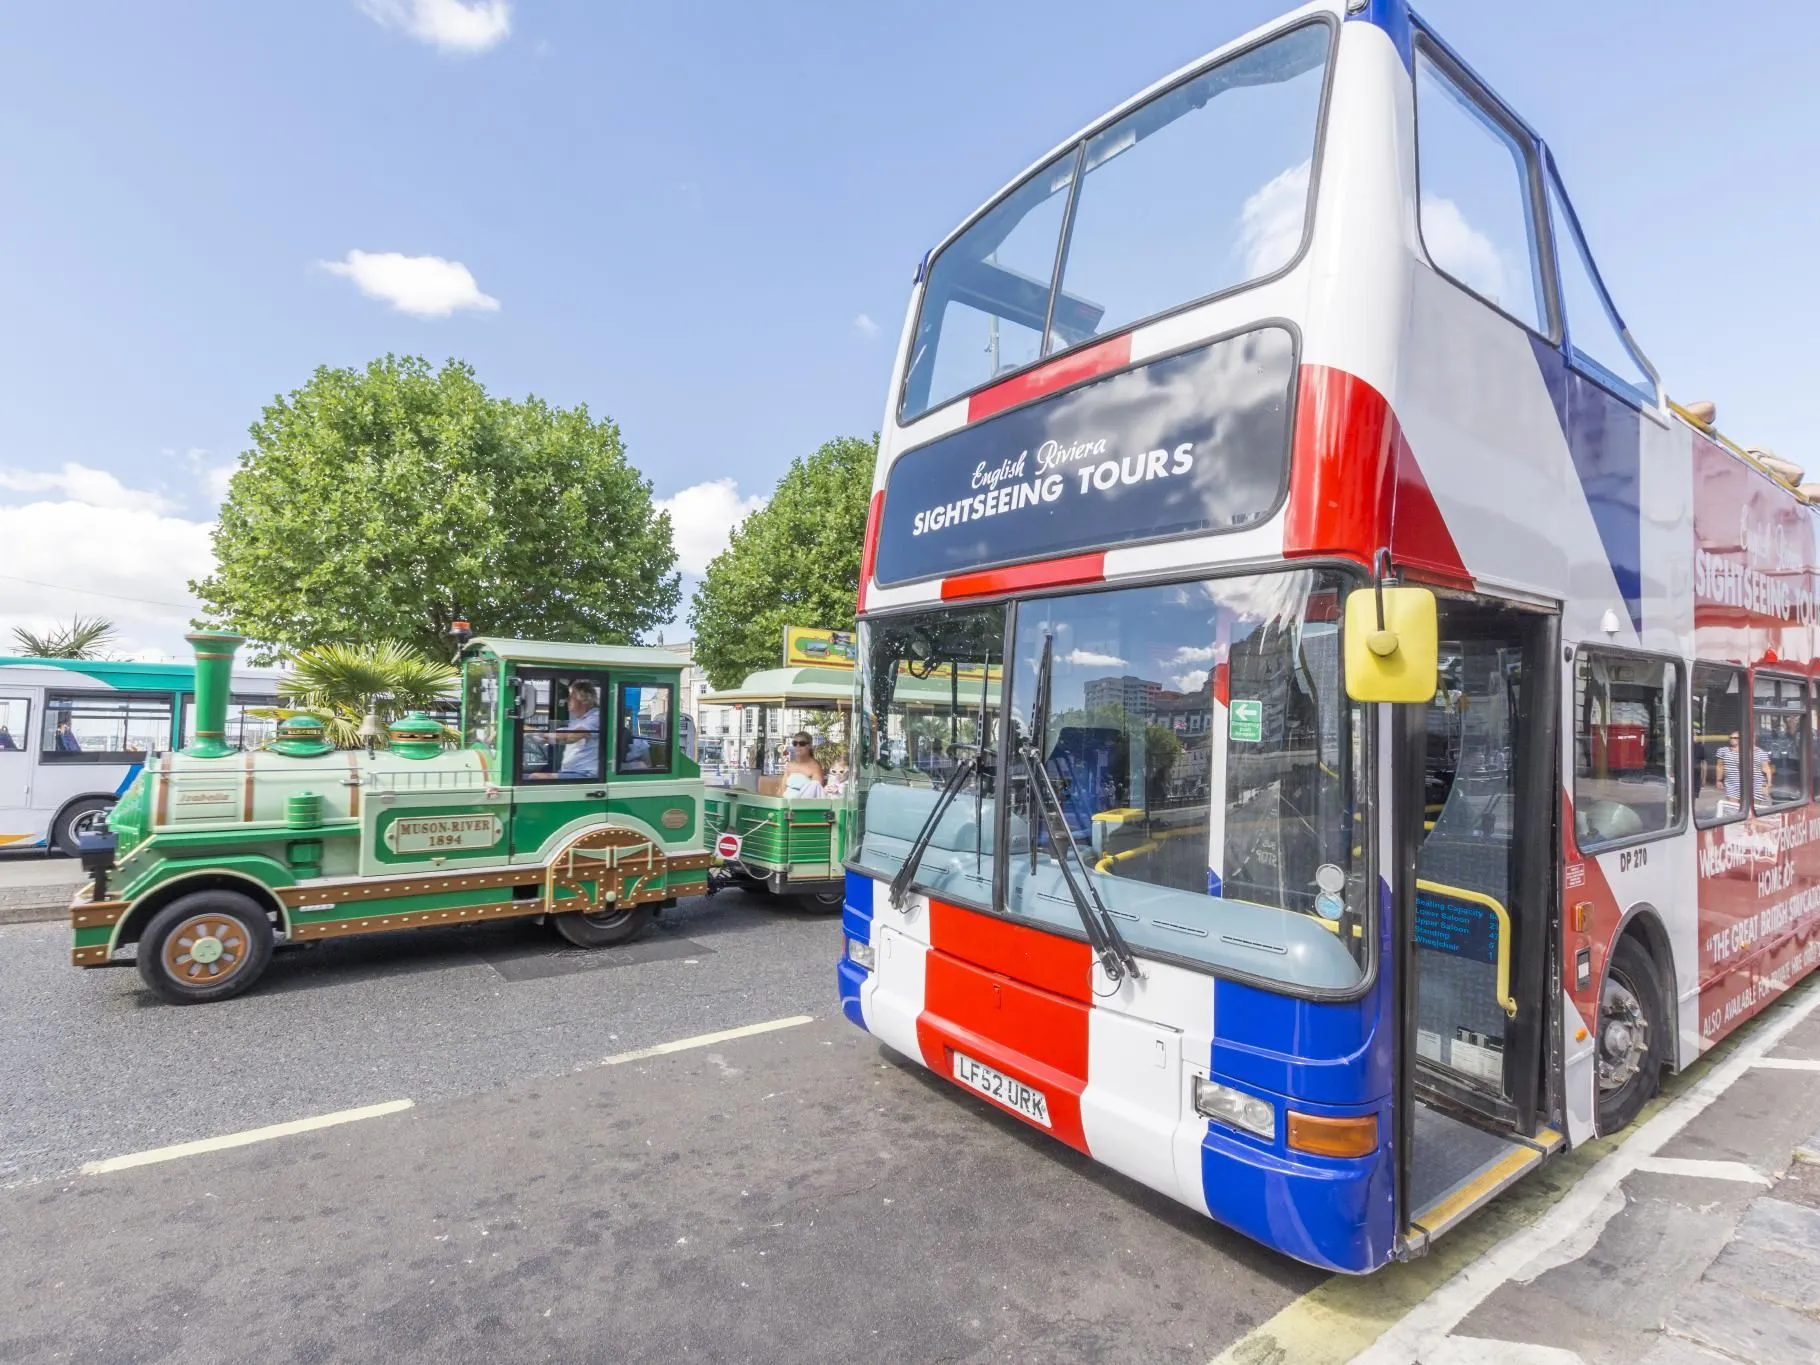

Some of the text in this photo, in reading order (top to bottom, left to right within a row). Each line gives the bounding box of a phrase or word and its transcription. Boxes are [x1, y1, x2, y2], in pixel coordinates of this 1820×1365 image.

[972, 439, 1106, 489] English Riviera
[912, 443, 1194, 536] SIGHTSEEING TOURS
[1695, 548, 1791, 622] SIGHTSEEING
[400, 820, 491, 835] MUSON-RIVER
[428, 835, 462, 847] 1894
[1620, 847, 1648, 873] DP 270
[1441, 912, 1470, 924] Saloon
[1441, 921, 1469, 934] Saloon
[1447, 904, 1483, 919] Capacity
[1731, 914, 1759, 953] GREAT
[1703, 1008, 1722, 1038] ALSO
[1724, 982, 1757, 1024] AVAILABLE
[960, 1056, 1044, 1120] LF52 URK
